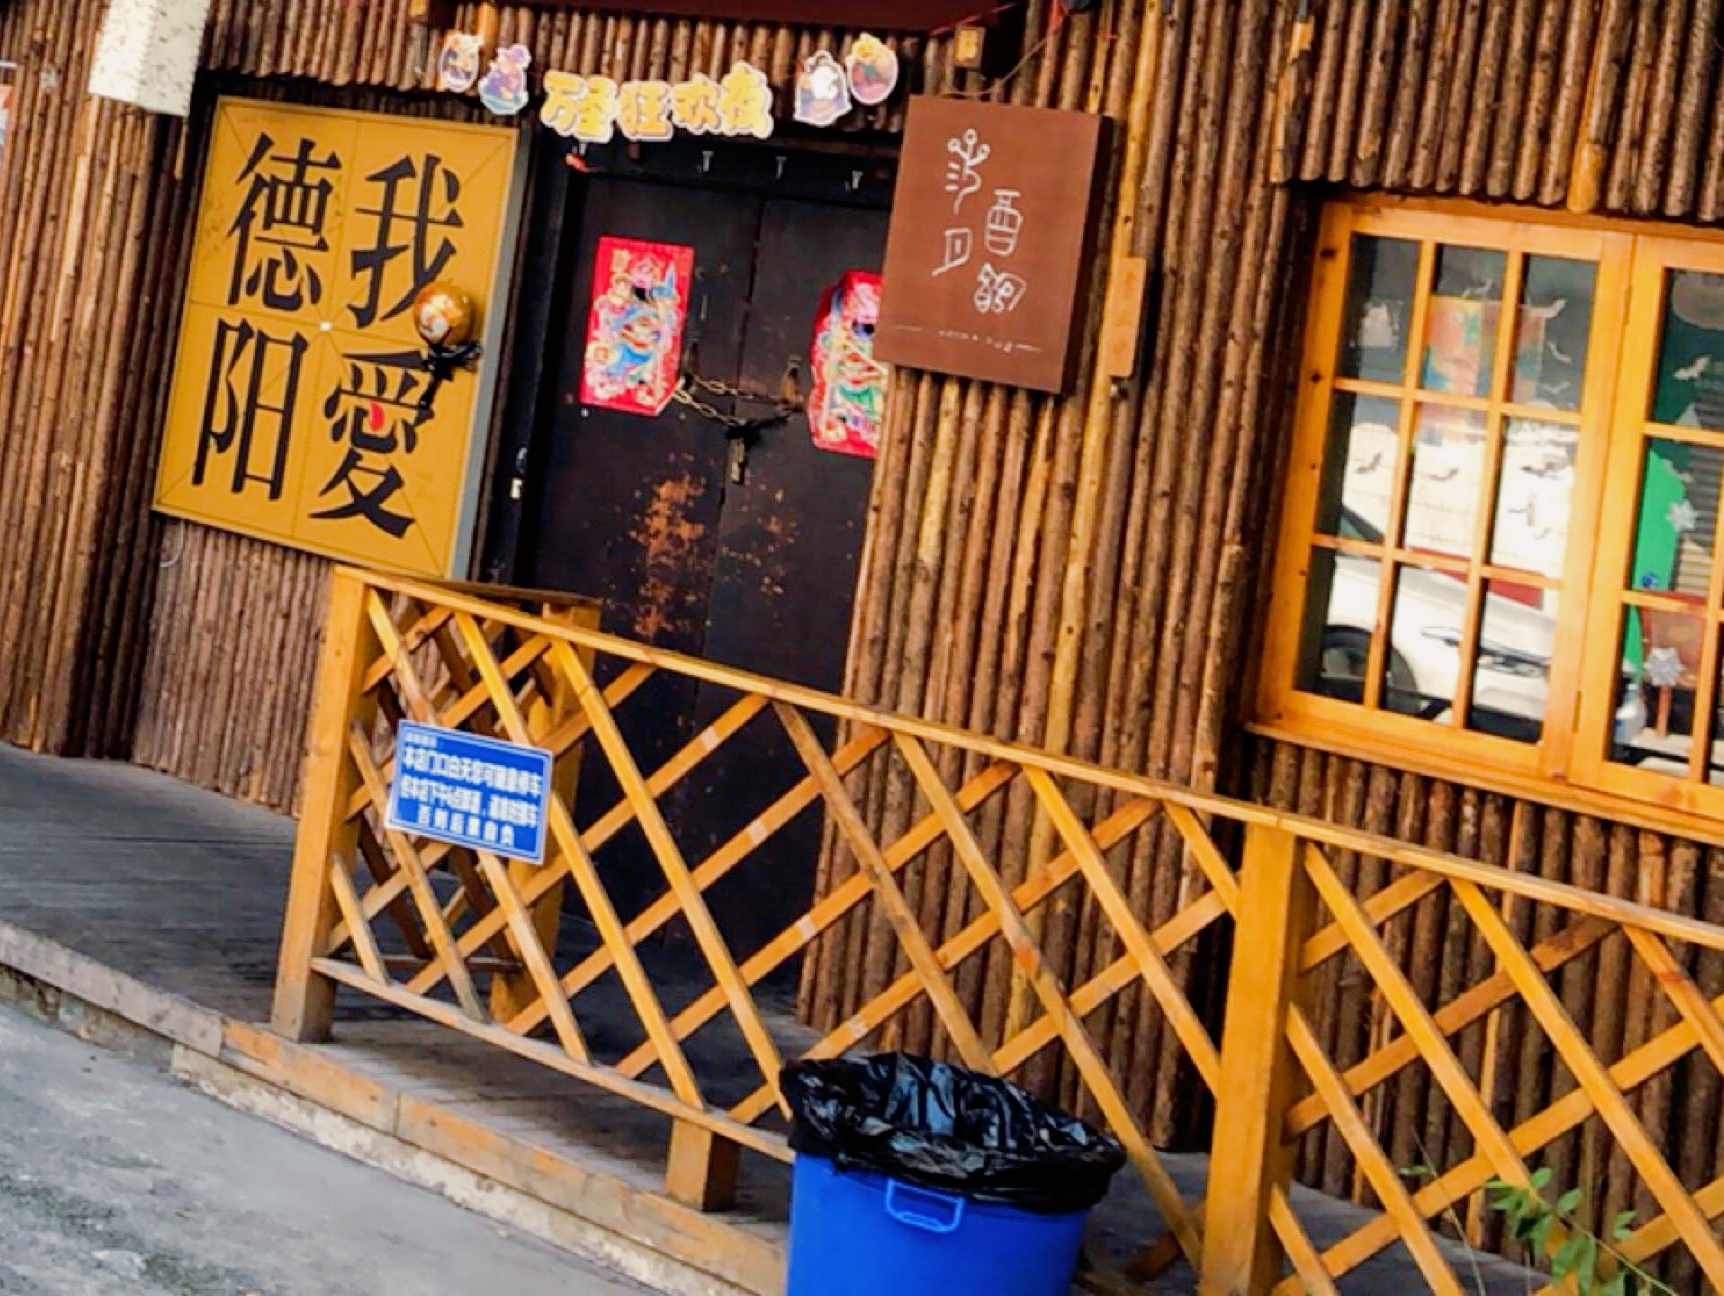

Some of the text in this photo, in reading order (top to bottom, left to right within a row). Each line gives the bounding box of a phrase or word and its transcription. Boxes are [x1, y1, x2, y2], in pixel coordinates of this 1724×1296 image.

[540, 61, 774, 144] 万圣狂欢夜
